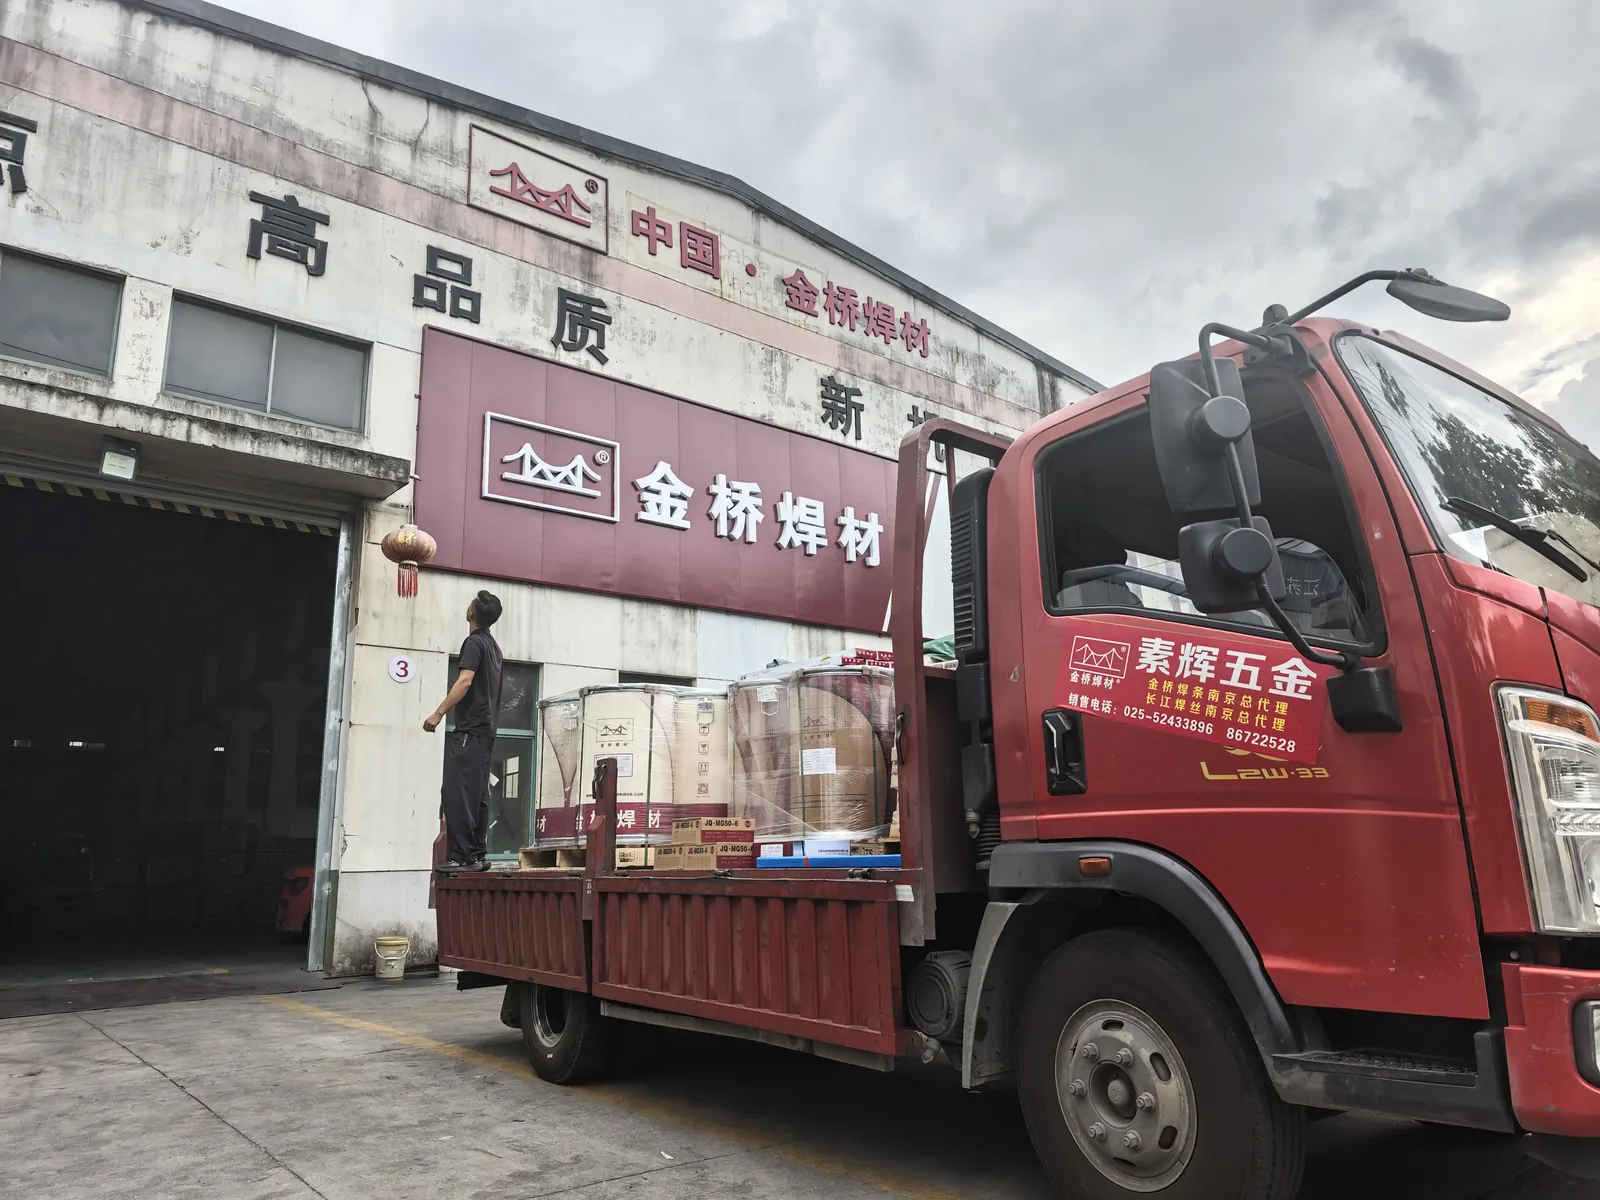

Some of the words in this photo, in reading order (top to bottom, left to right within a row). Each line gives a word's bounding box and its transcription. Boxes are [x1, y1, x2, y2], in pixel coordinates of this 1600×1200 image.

[633, 461, 884, 568] 金桥焊材
[395, 660, 409, 677] 3
[1069, 670, 1114, 690] 金桥焊材
[1135, 636, 1317, 700] 素辉五金
[1145, 692, 1286, 732] 长江焊丝南京总代理
[1147, 677, 1288, 716] 金桥焊条南京总代理
[1123, 705, 1214, 735] 025-52433896
[1226, 727, 1296, 753] 86722528
